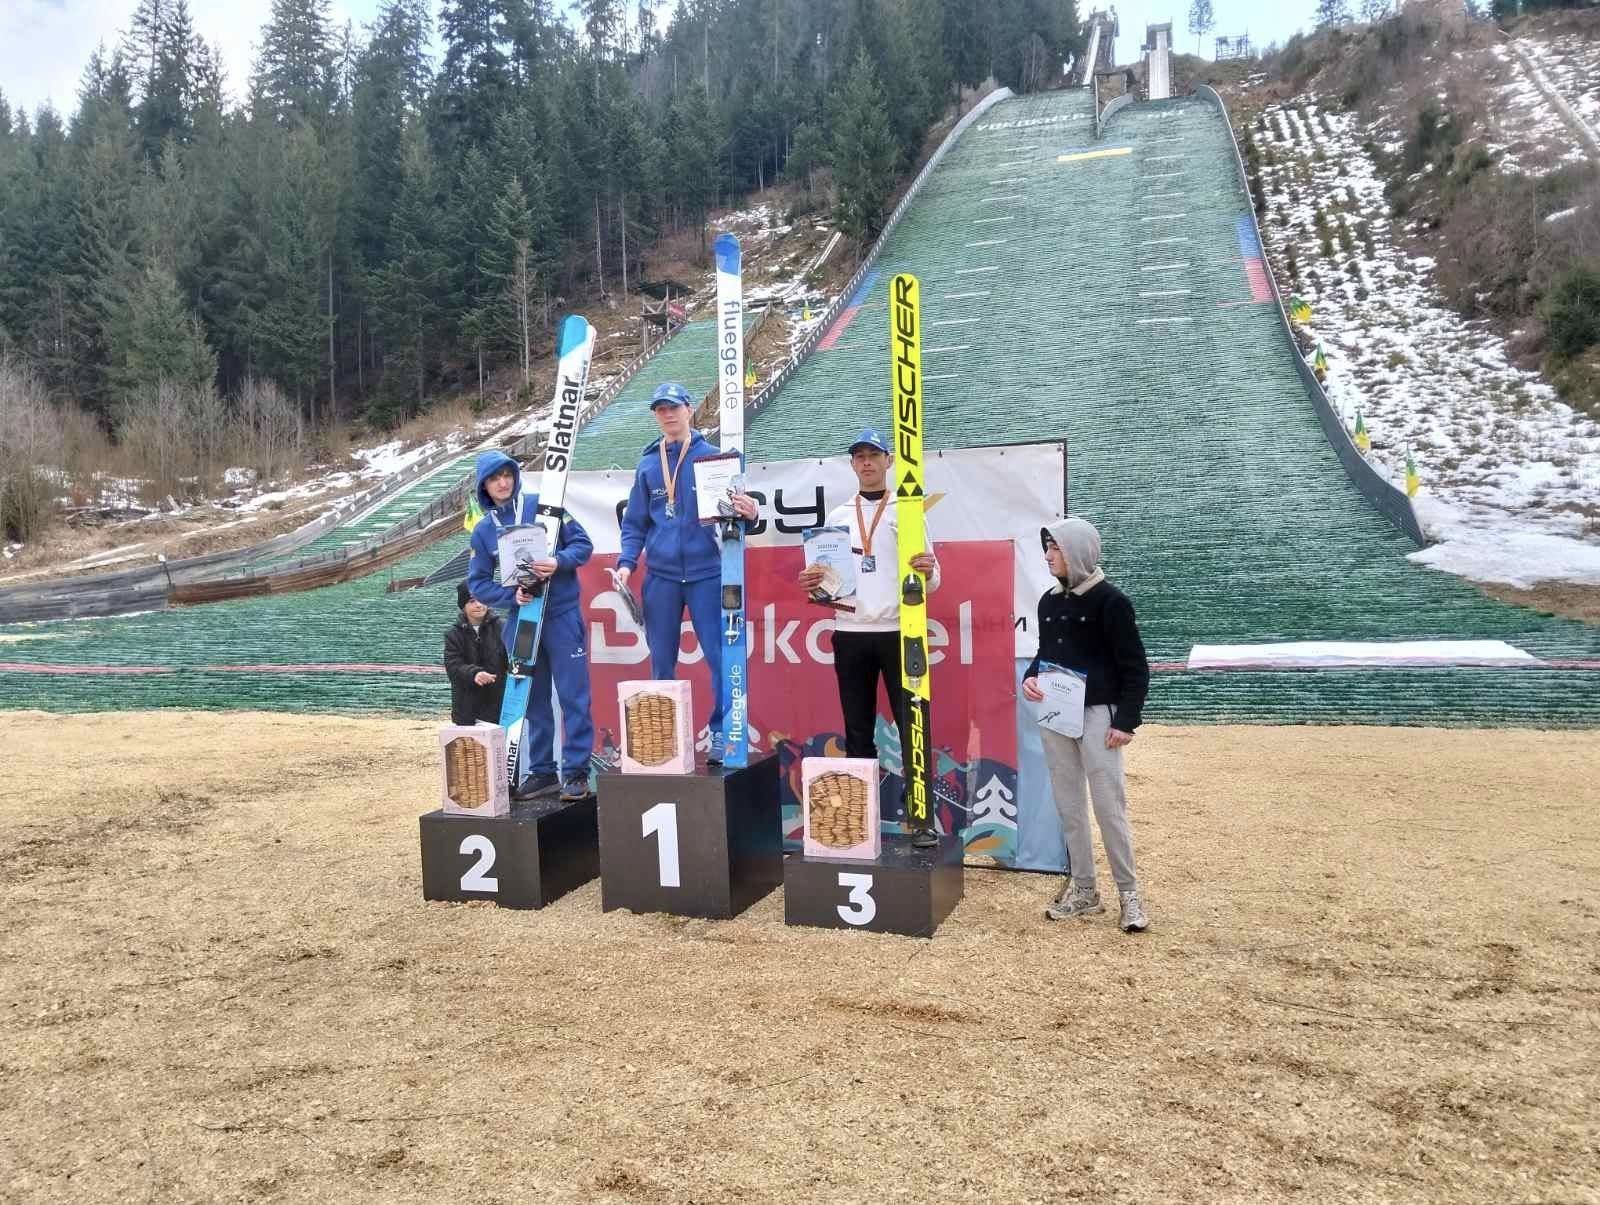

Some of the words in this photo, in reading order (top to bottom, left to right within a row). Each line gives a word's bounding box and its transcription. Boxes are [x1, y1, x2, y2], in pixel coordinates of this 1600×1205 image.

[721, 300, 741, 410] fluege.de
[896, 275, 918, 467] FISCHER
[545, 375, 580, 473] Slatnar
[728, 664, 746, 742] fluege.de
[910, 705, 927, 820] FISCHER
[459, 834, 499, 893] 2
[641, 802, 681, 888] 1
[837, 872, 877, 926] 3
